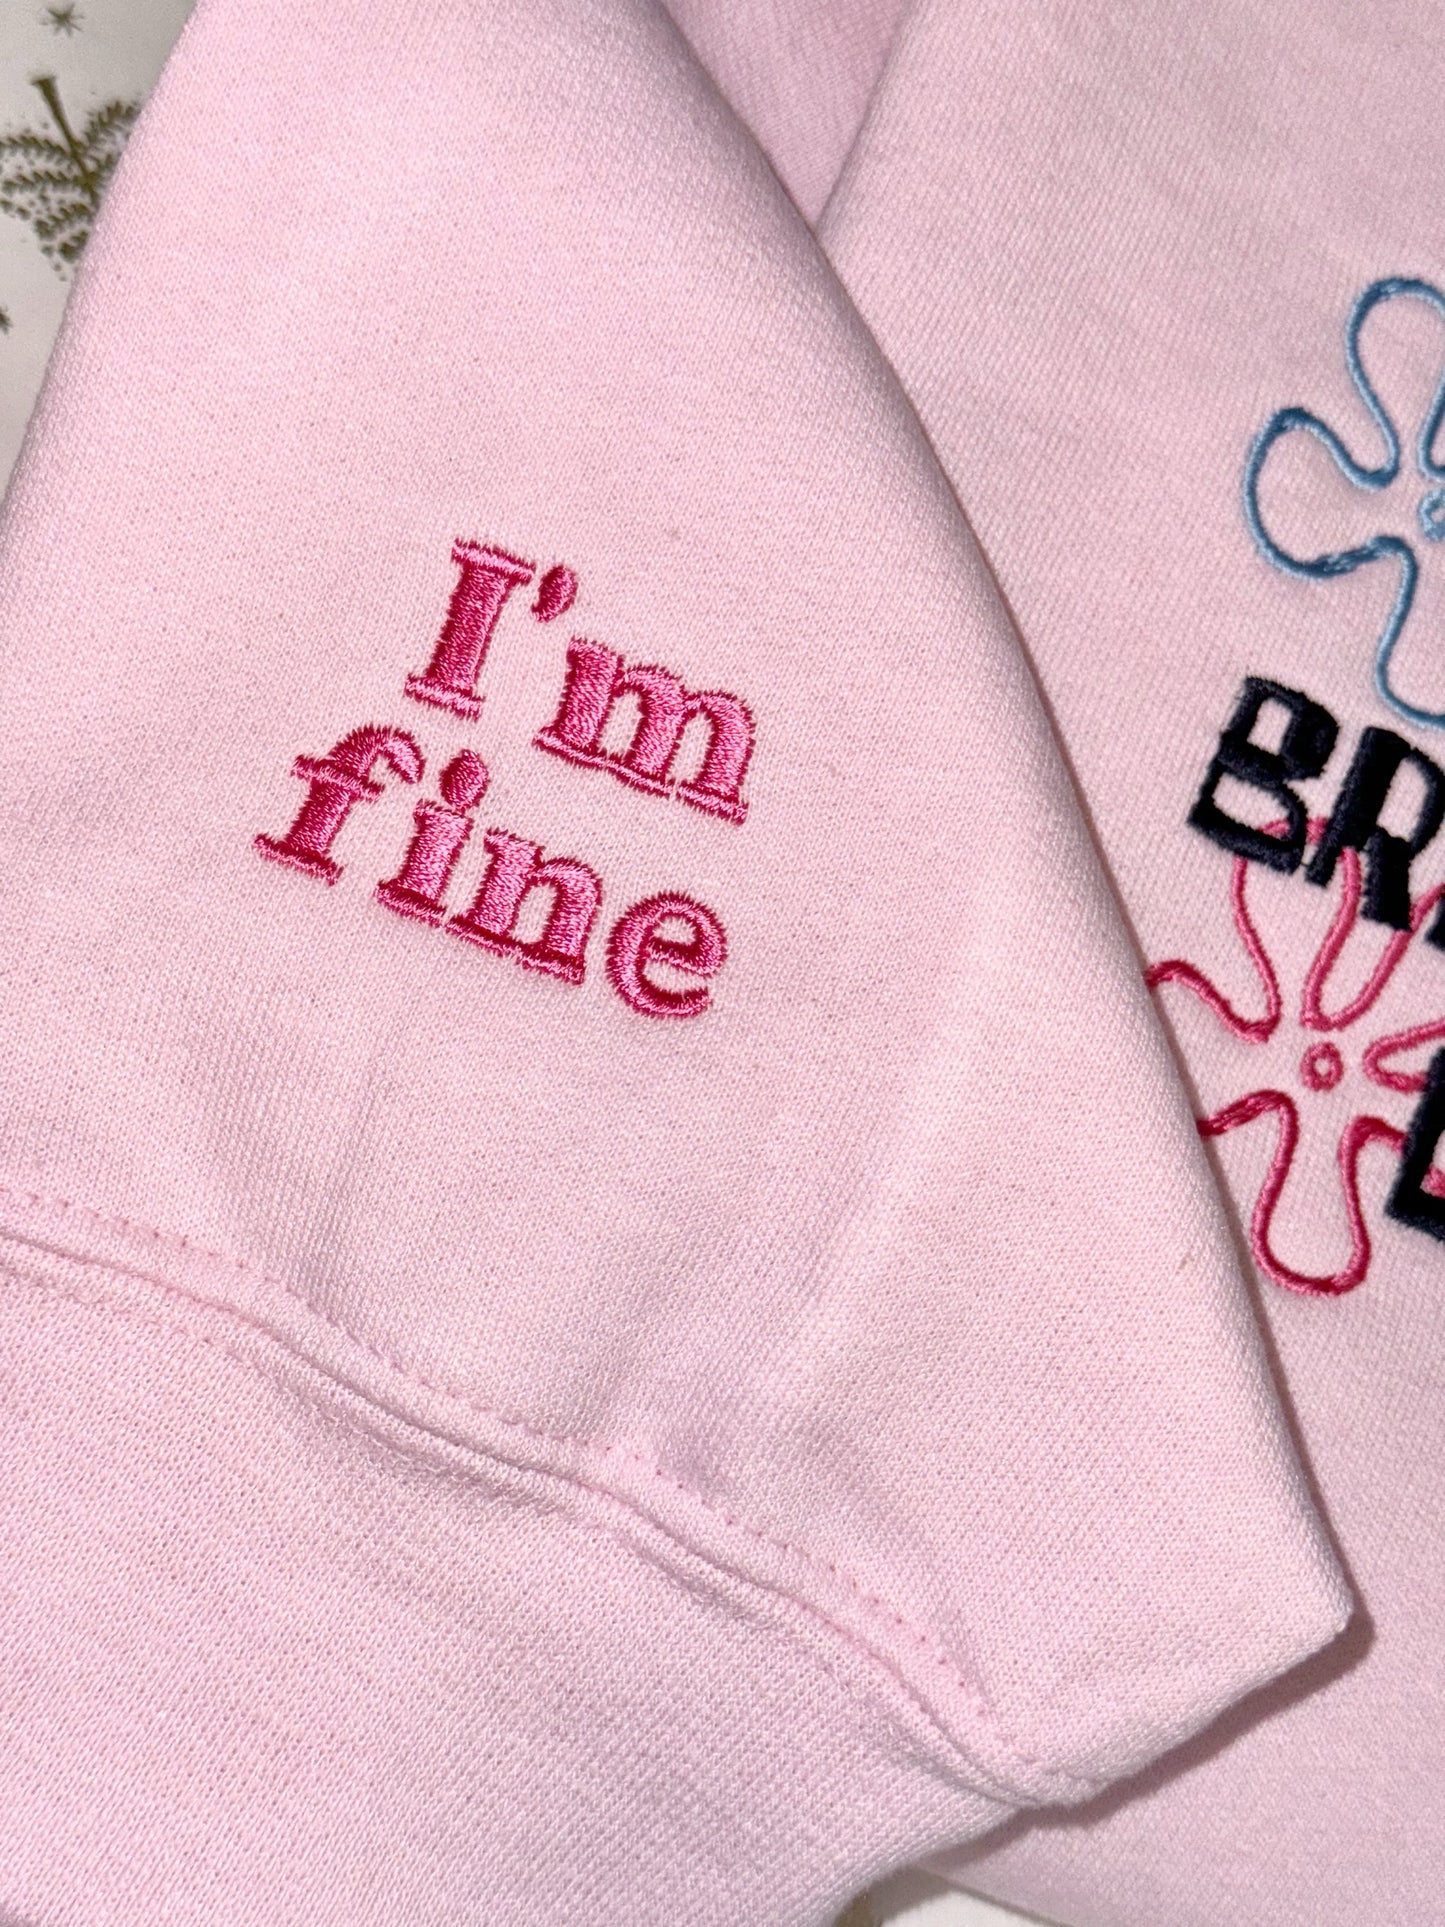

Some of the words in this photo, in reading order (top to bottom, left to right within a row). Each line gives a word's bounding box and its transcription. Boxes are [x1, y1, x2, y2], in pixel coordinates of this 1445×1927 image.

[404, 538, 756, 825] I'm
[1187, 676, 1445, 950] BR
[253, 724, 727, 1019] fine
